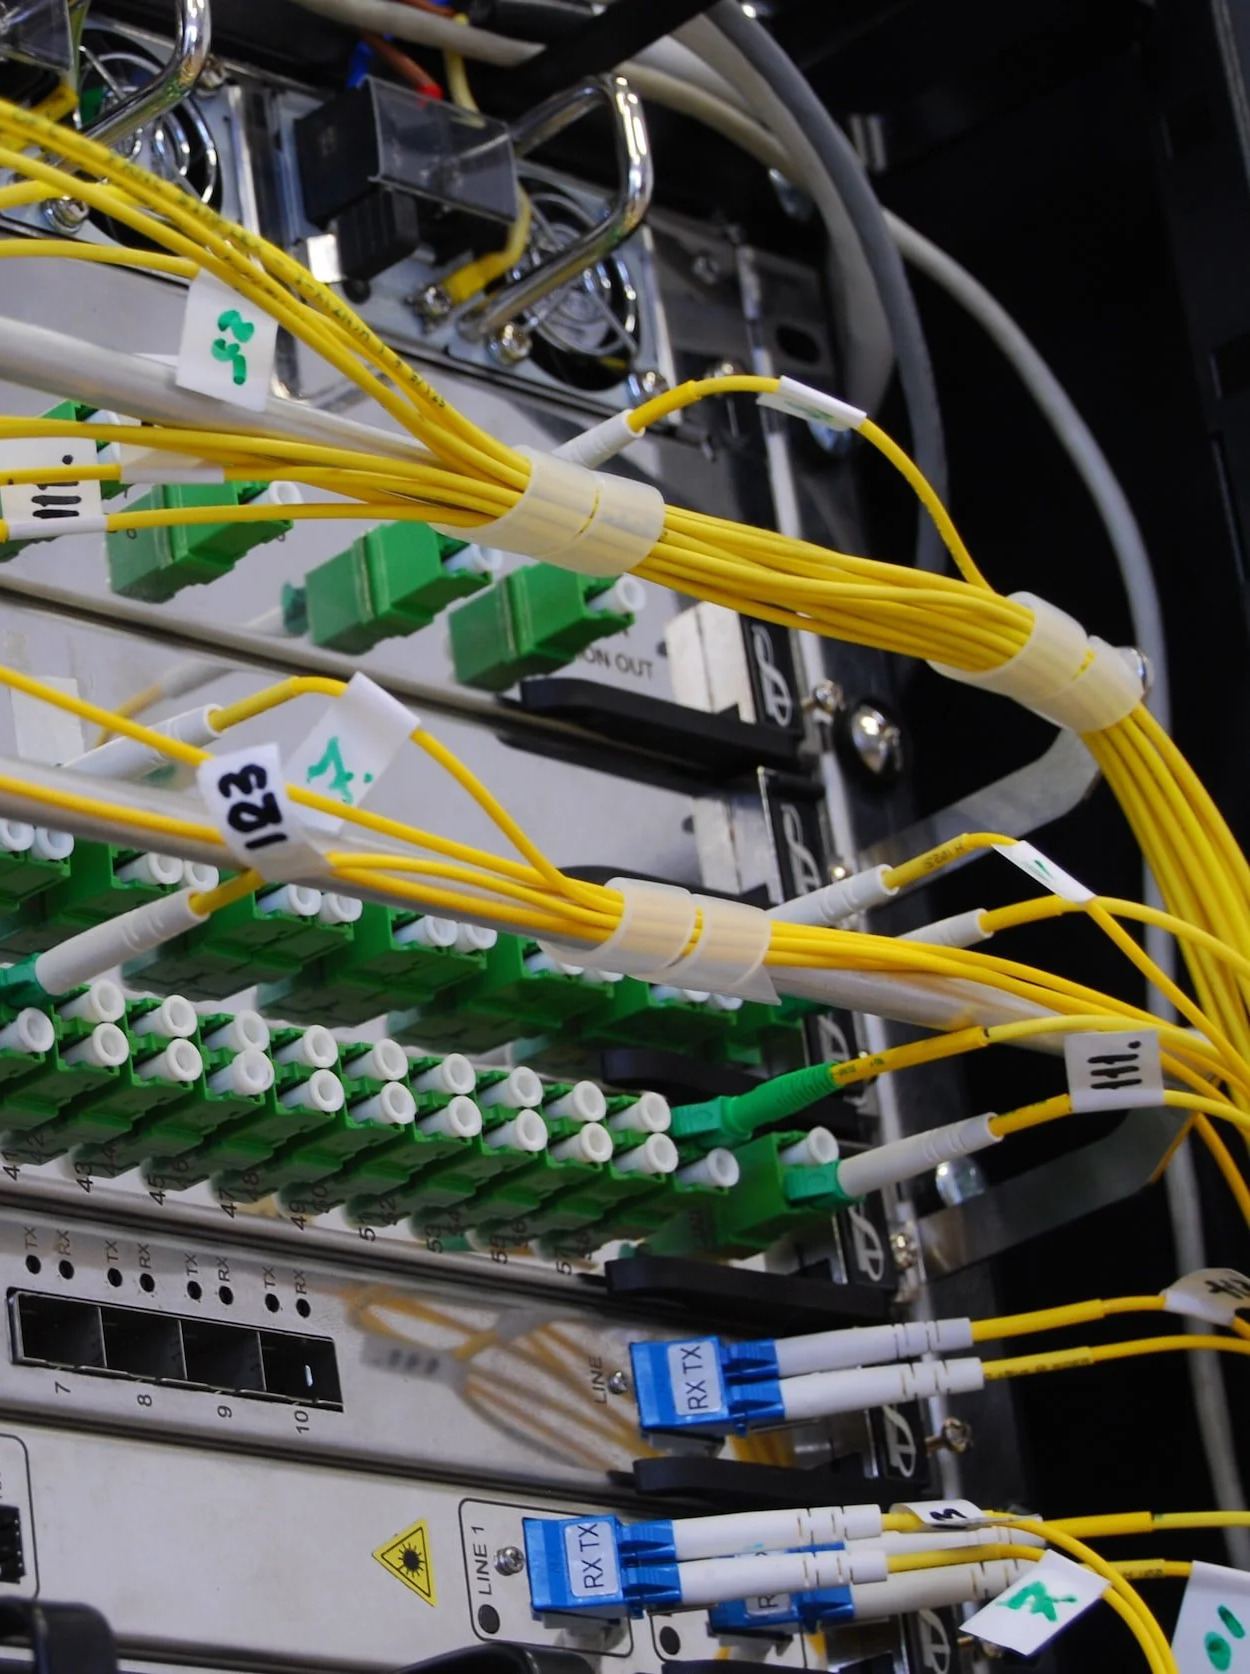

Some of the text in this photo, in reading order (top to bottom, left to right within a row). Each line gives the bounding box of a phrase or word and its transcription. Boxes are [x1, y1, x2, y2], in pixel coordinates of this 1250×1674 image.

[575, 648, 653, 679] ON OUT
[2, 1150, 21, 1181] 41
[75, 1161, 94, 1193] 43
[148, 1175, 167, 1206] 45
[218, 1186, 237, 1219] 47
[289, 1201, 308, 1231] 49
[358, 1212, 376, 1242] 51
[24, 1226, 39, 1249] TX
[56, 1229, 72, 1256] RX
[105, 1240, 120, 1262] TX
[424, 1224, 443, 1253] 53
[138, 1243, 153, 1269] RX
[184, 1252, 199, 1276] TX
[215, 1256, 231, 1282] RX
[262, 1266, 277, 1289] TX
[292, 1269, 308, 1295] RX
[54, 1381, 72, 1394] 7
[588, 1356, 607, 1406] LINE
[680, 1345, 710, 1411] RX TX
[136, 1393, 154, 1408] 8
[217, 1404, 233, 1419] 9
[293, 1409, 311, 1435] 10
[470, 1525, 493, 1596] LINE 1
[577, 1523, 605, 1589] RX TX
[757, 1592, 780, 1610] R
